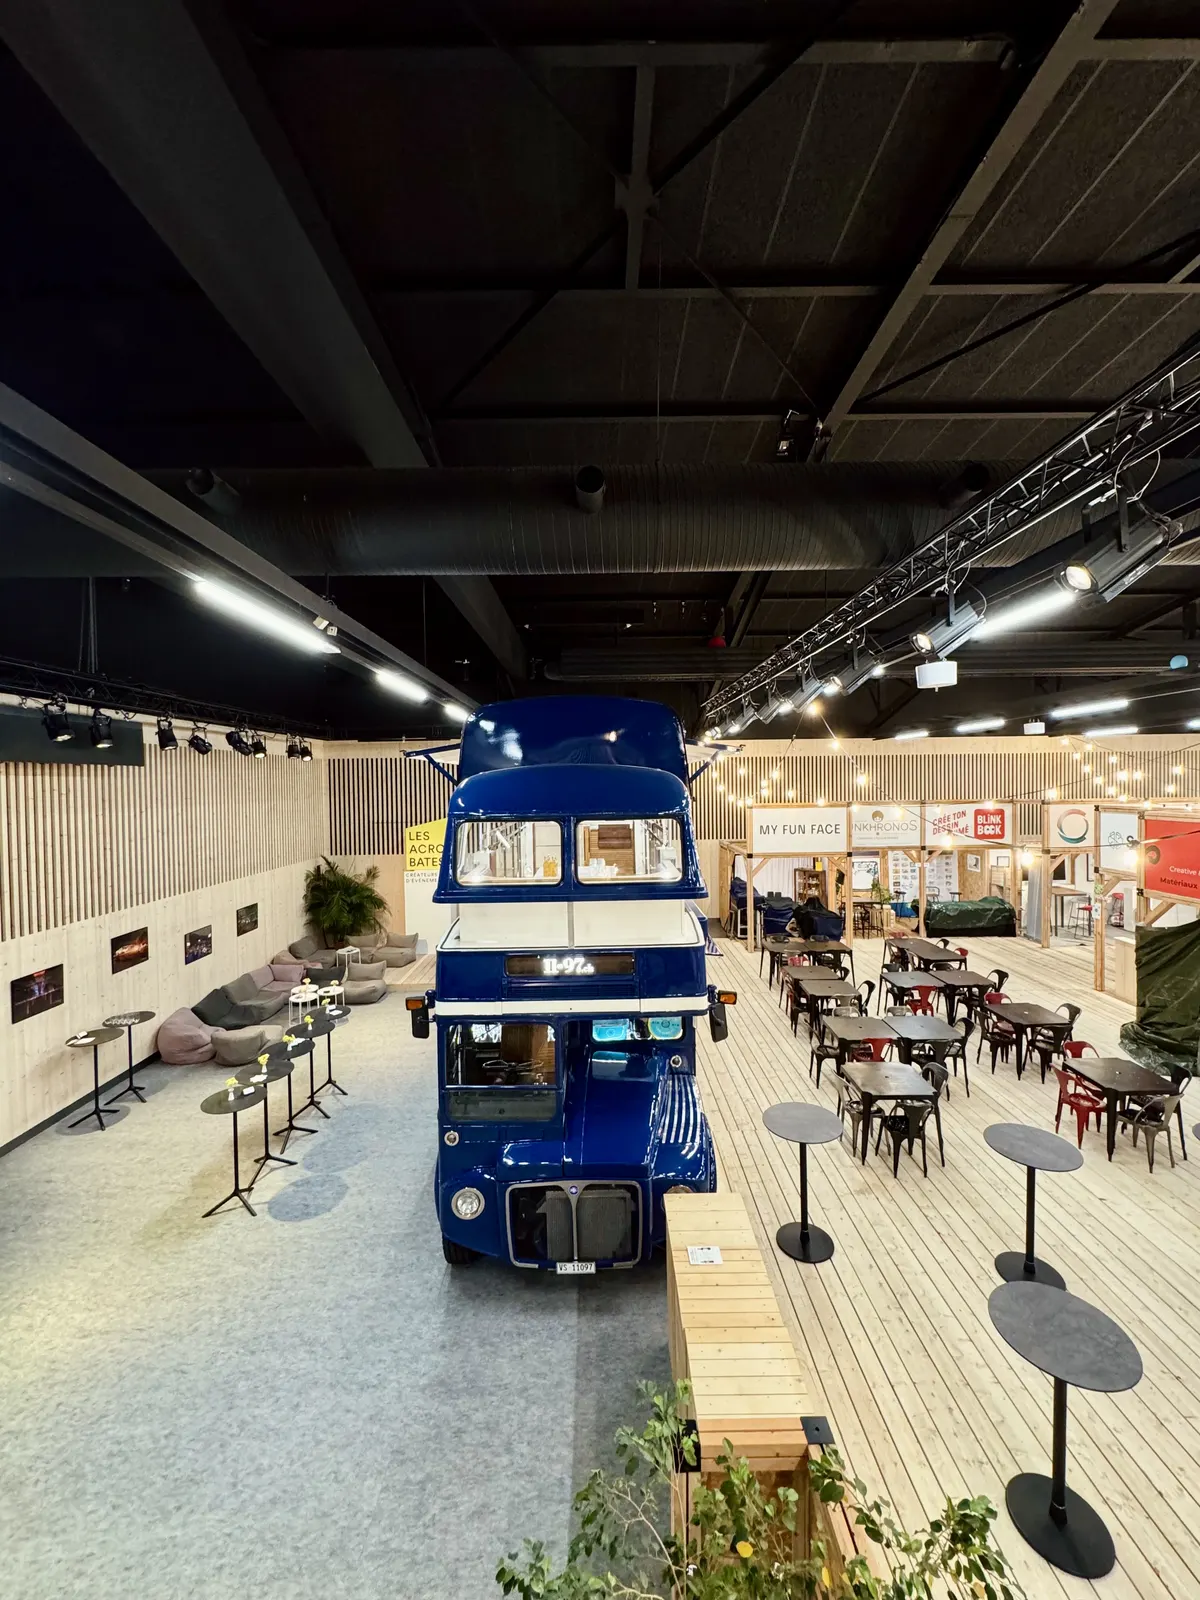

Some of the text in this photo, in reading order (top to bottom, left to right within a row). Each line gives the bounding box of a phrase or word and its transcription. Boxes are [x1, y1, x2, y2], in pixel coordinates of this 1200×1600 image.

[932, 810, 966, 826] CRÉE TON
[759, 823, 841, 835] MY FUN FACE
[851, 820, 918, 832] NKHRONOS
[932, 821, 959, 836] DESSIN
[977, 825, 1002, 835] BOOK
[408, 831, 430, 841] LES
[1169, 865, 1197, 875] Creative
[1160, 877, 1198, 889] Matériaux
[559, 1263, 593, 1271] VS 11097
